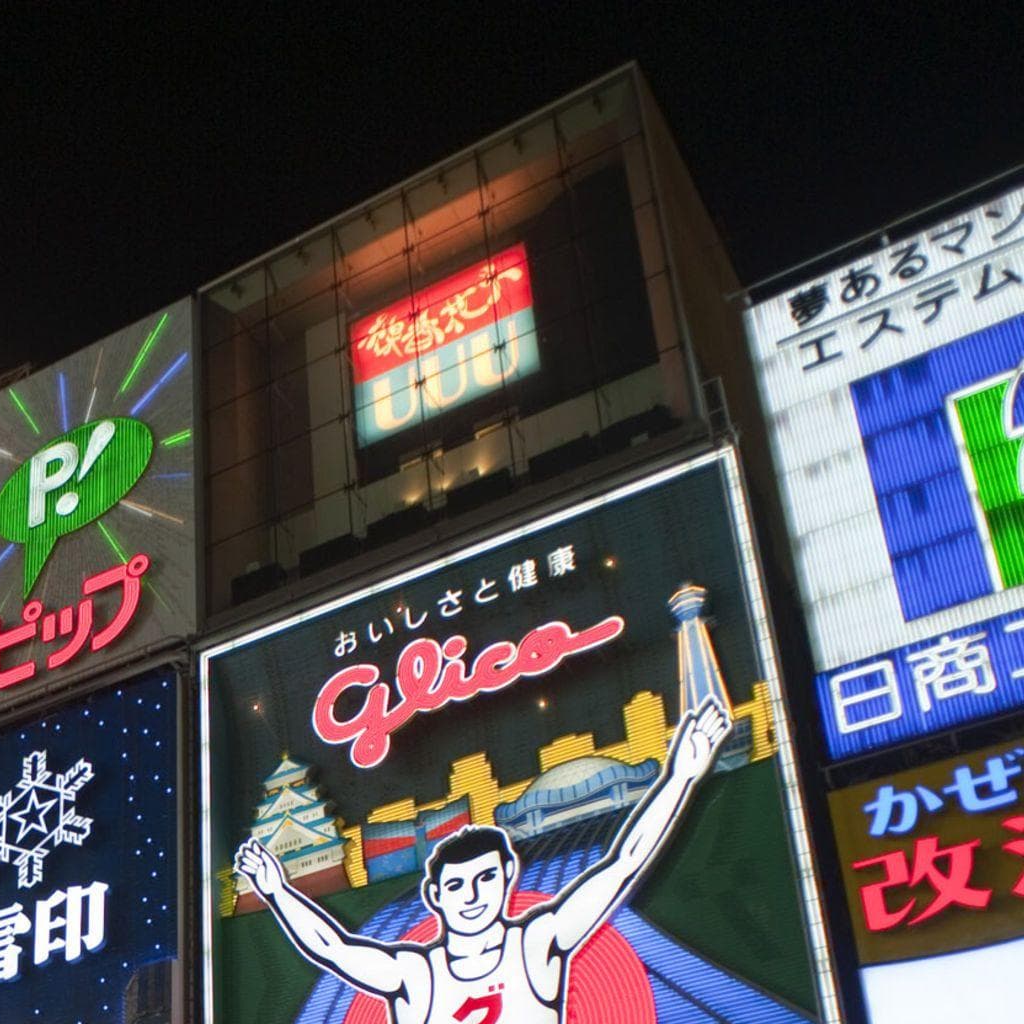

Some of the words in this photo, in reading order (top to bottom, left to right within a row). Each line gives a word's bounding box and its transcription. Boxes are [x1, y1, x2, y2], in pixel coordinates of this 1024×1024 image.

[798, 263, 1024, 371] エステム
[372, 319, 520, 432] UUU
[27, 420, 116, 529] P!
[334, 544, 577, 658] おいしさと健康
